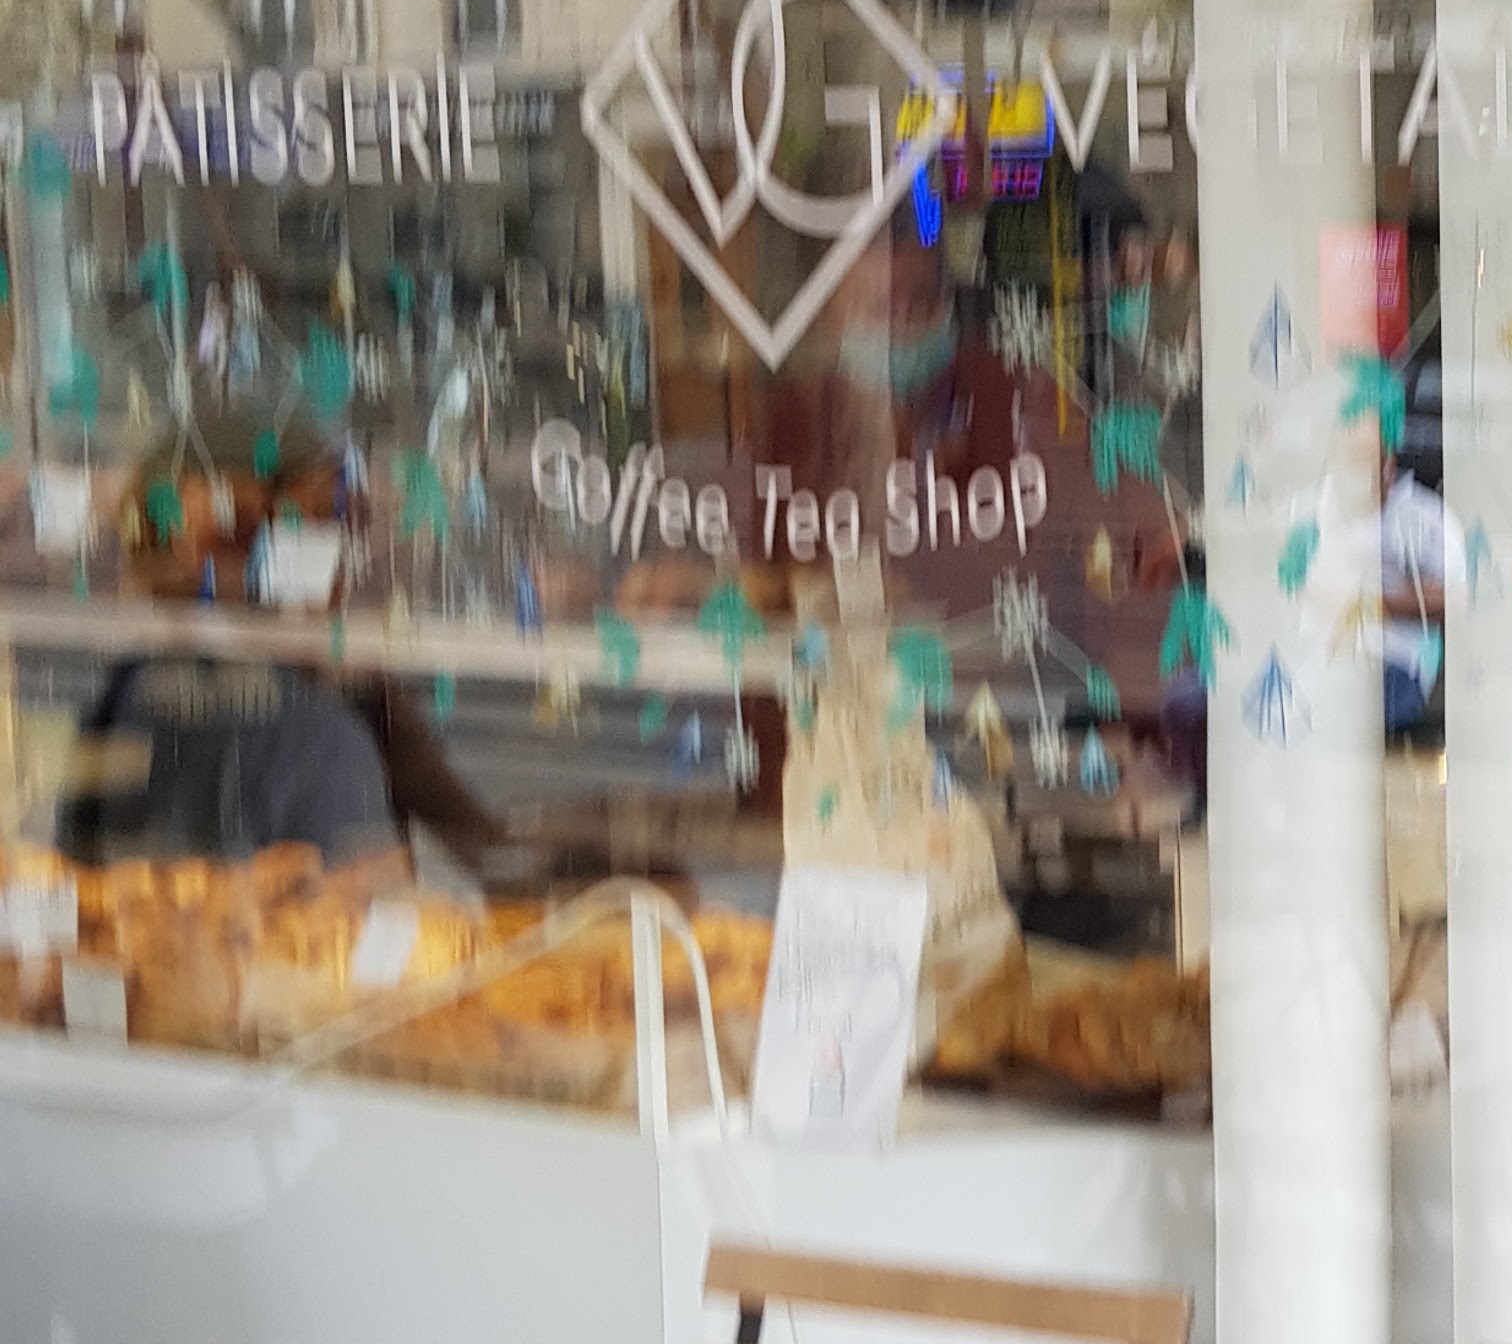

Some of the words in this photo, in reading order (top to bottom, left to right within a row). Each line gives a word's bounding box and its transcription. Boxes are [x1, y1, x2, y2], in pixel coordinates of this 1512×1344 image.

[531, 419, 728, 559] Coffee
[755, 463, 859, 562] Tea
[886, 451, 1047, 557] Shop
